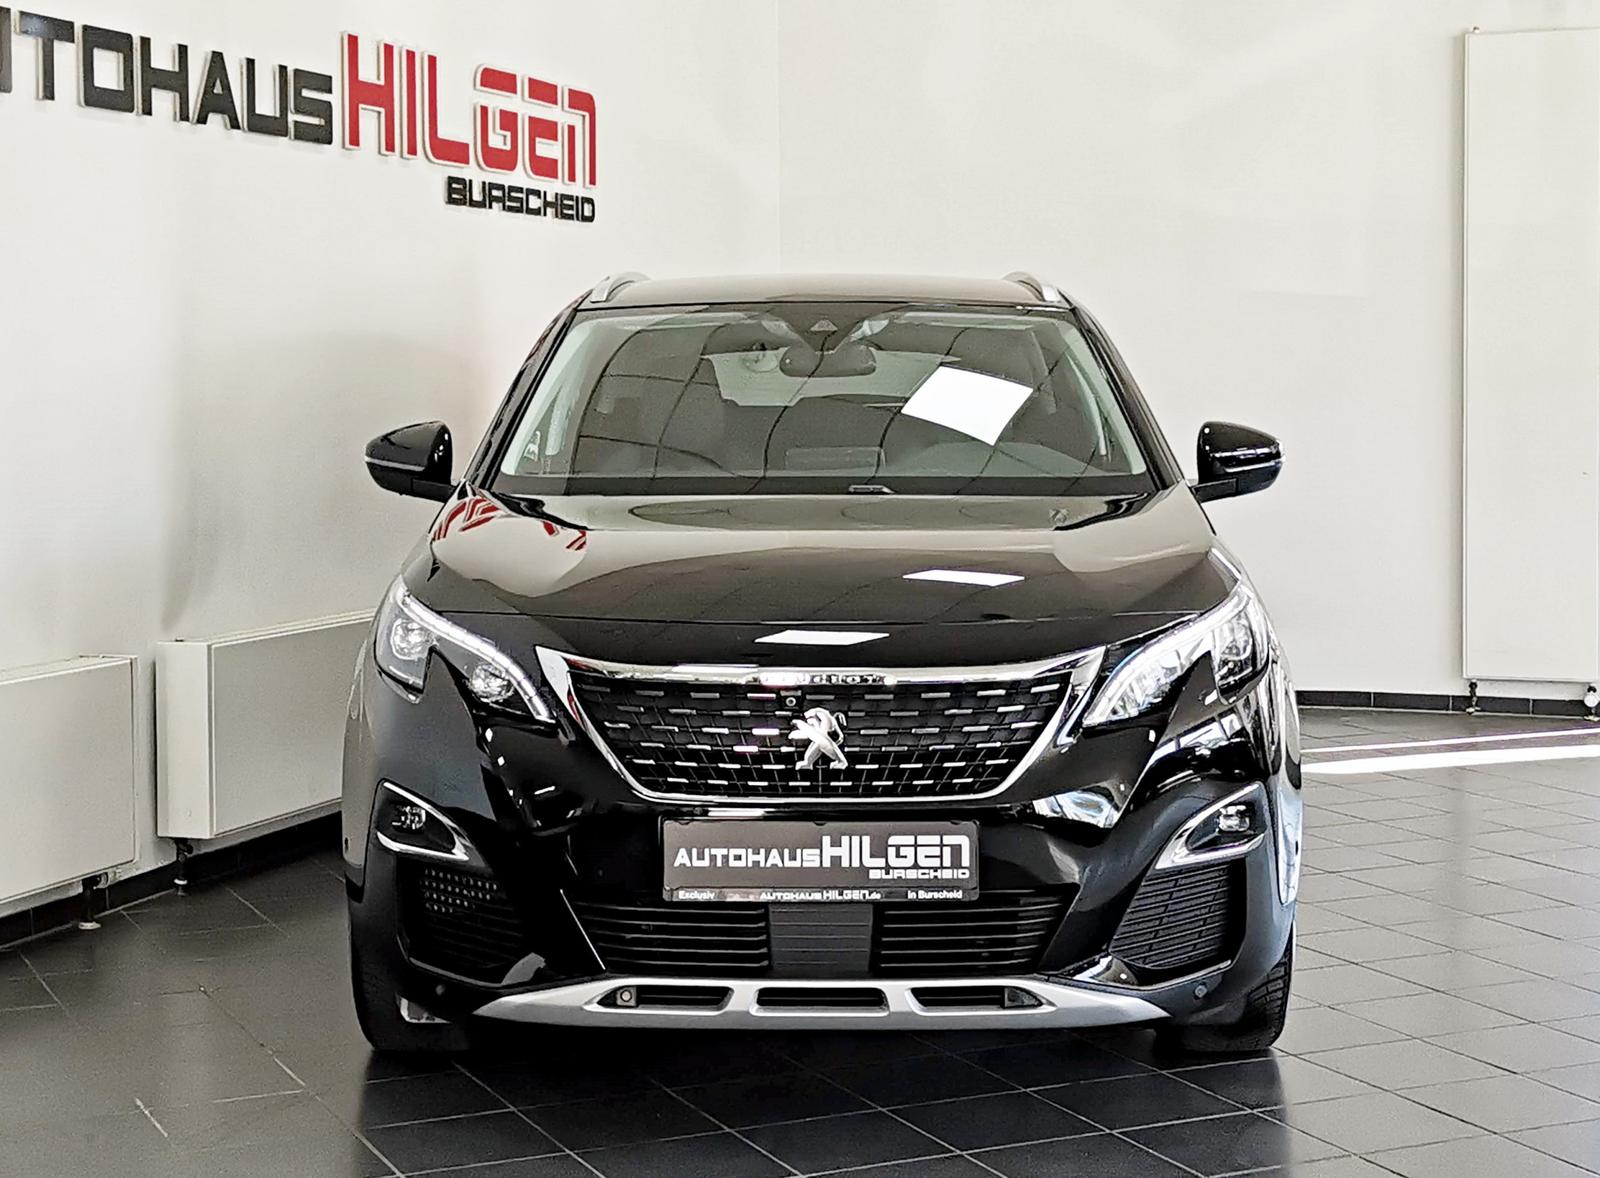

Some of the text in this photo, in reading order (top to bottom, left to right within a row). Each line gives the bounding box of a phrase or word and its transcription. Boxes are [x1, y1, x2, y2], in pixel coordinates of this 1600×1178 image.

[0, 6, 333, 145] TOHAUS
[446, 175, 596, 223] BURSCHEID
[868, 868, 970, 880] BURSCHEID
[678, 890, 716, 900] Exclusiv
[917, 890, 963, 900] Burscheid
